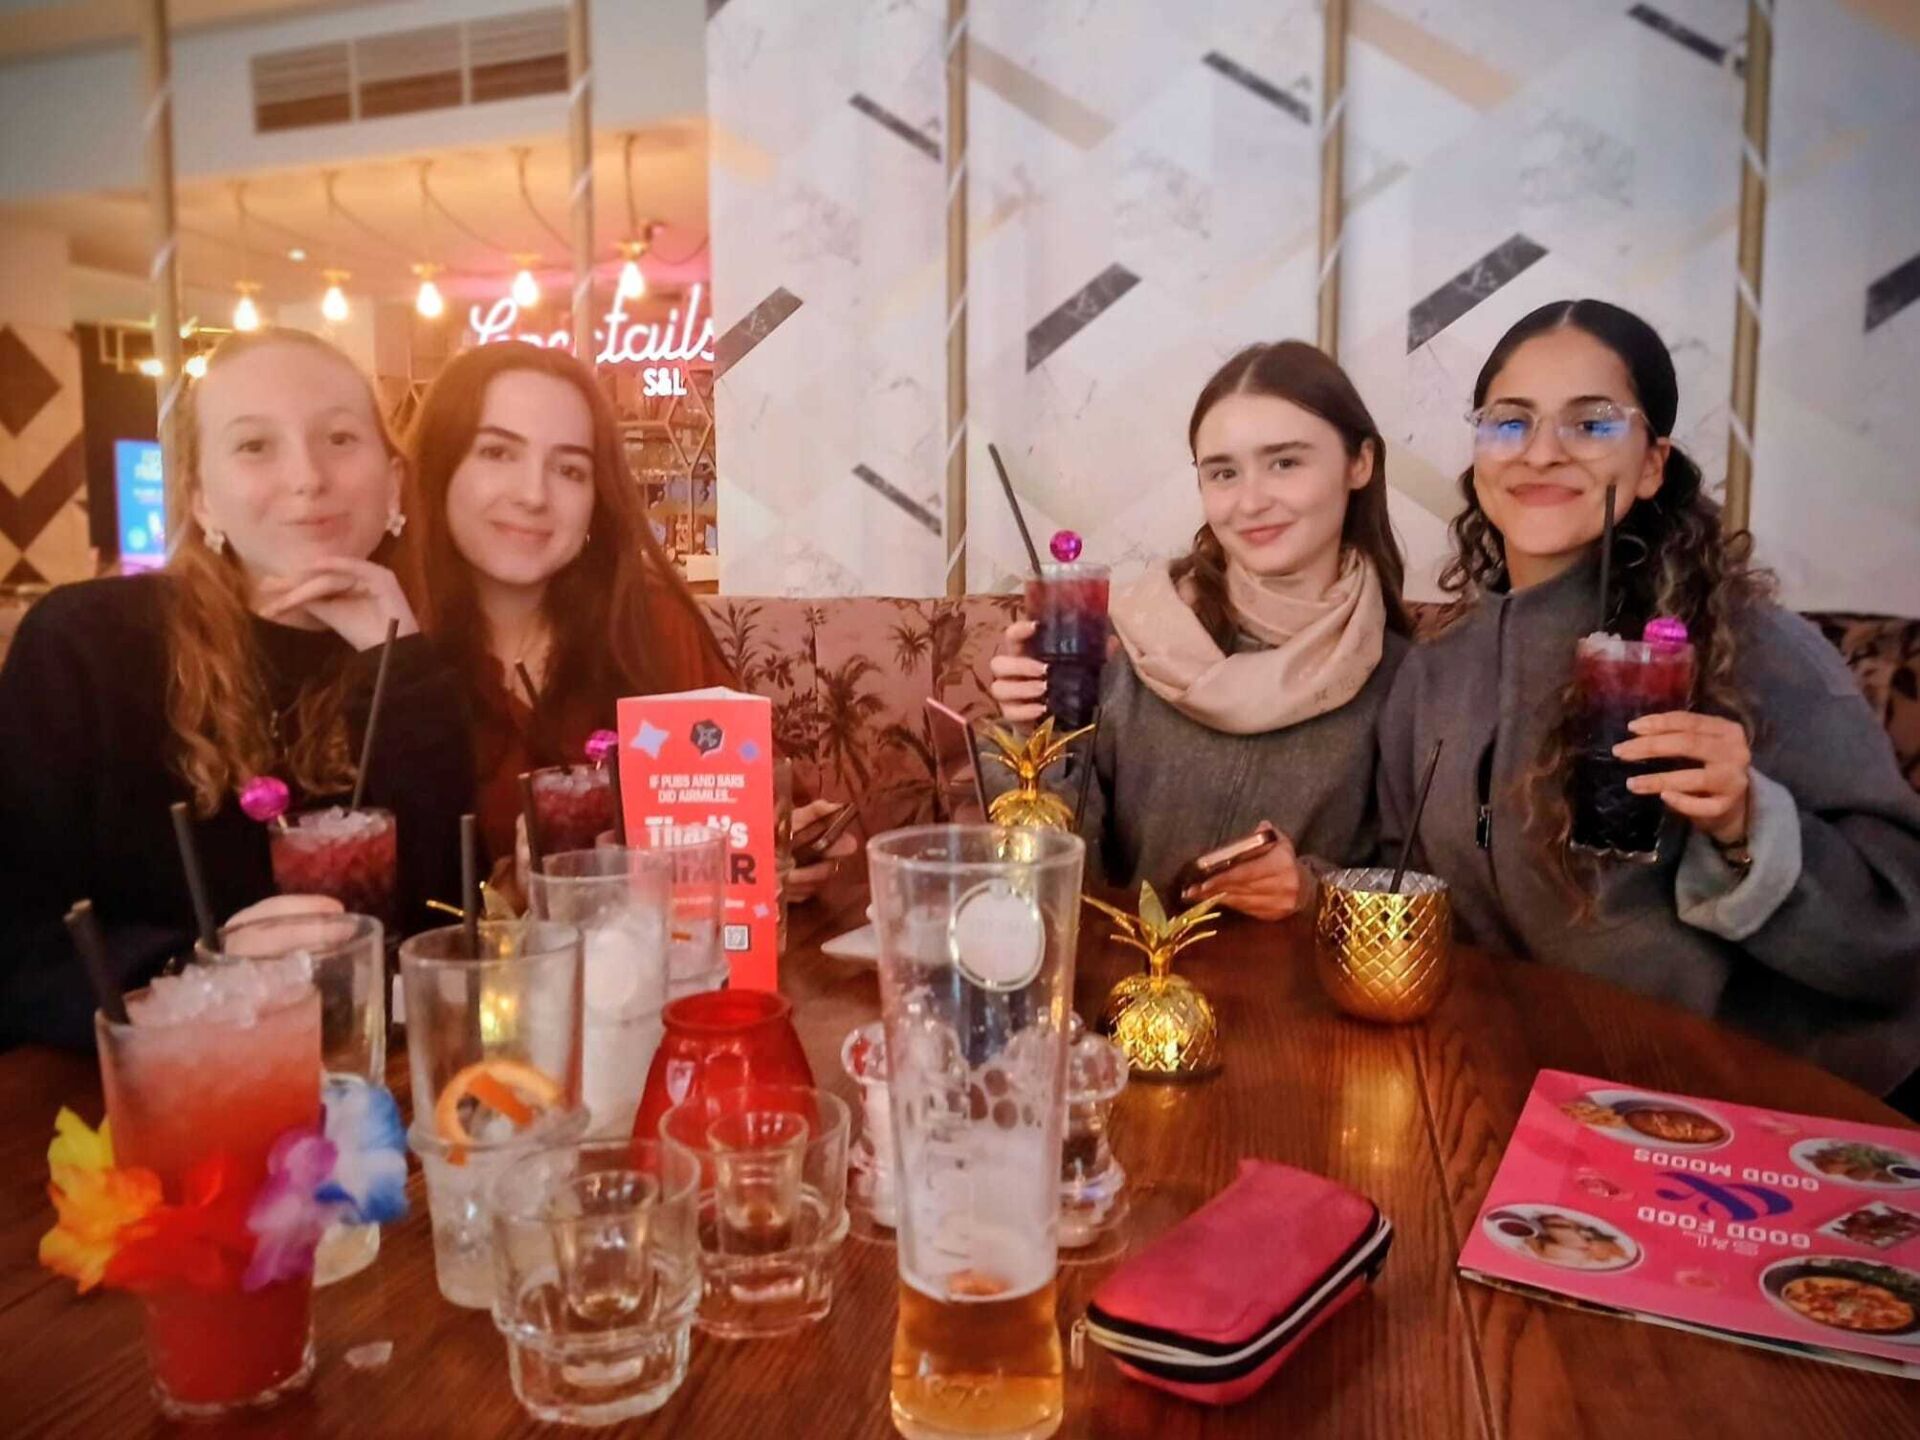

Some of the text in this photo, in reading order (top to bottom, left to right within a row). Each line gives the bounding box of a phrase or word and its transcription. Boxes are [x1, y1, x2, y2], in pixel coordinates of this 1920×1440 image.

[642, 367, 687, 397] S&L
[692, 774, 715, 788] AND
[1633, 1148, 1819, 1191] GOOD MOODS
[1637, 1206, 1811, 1249] GOOD FOOD
